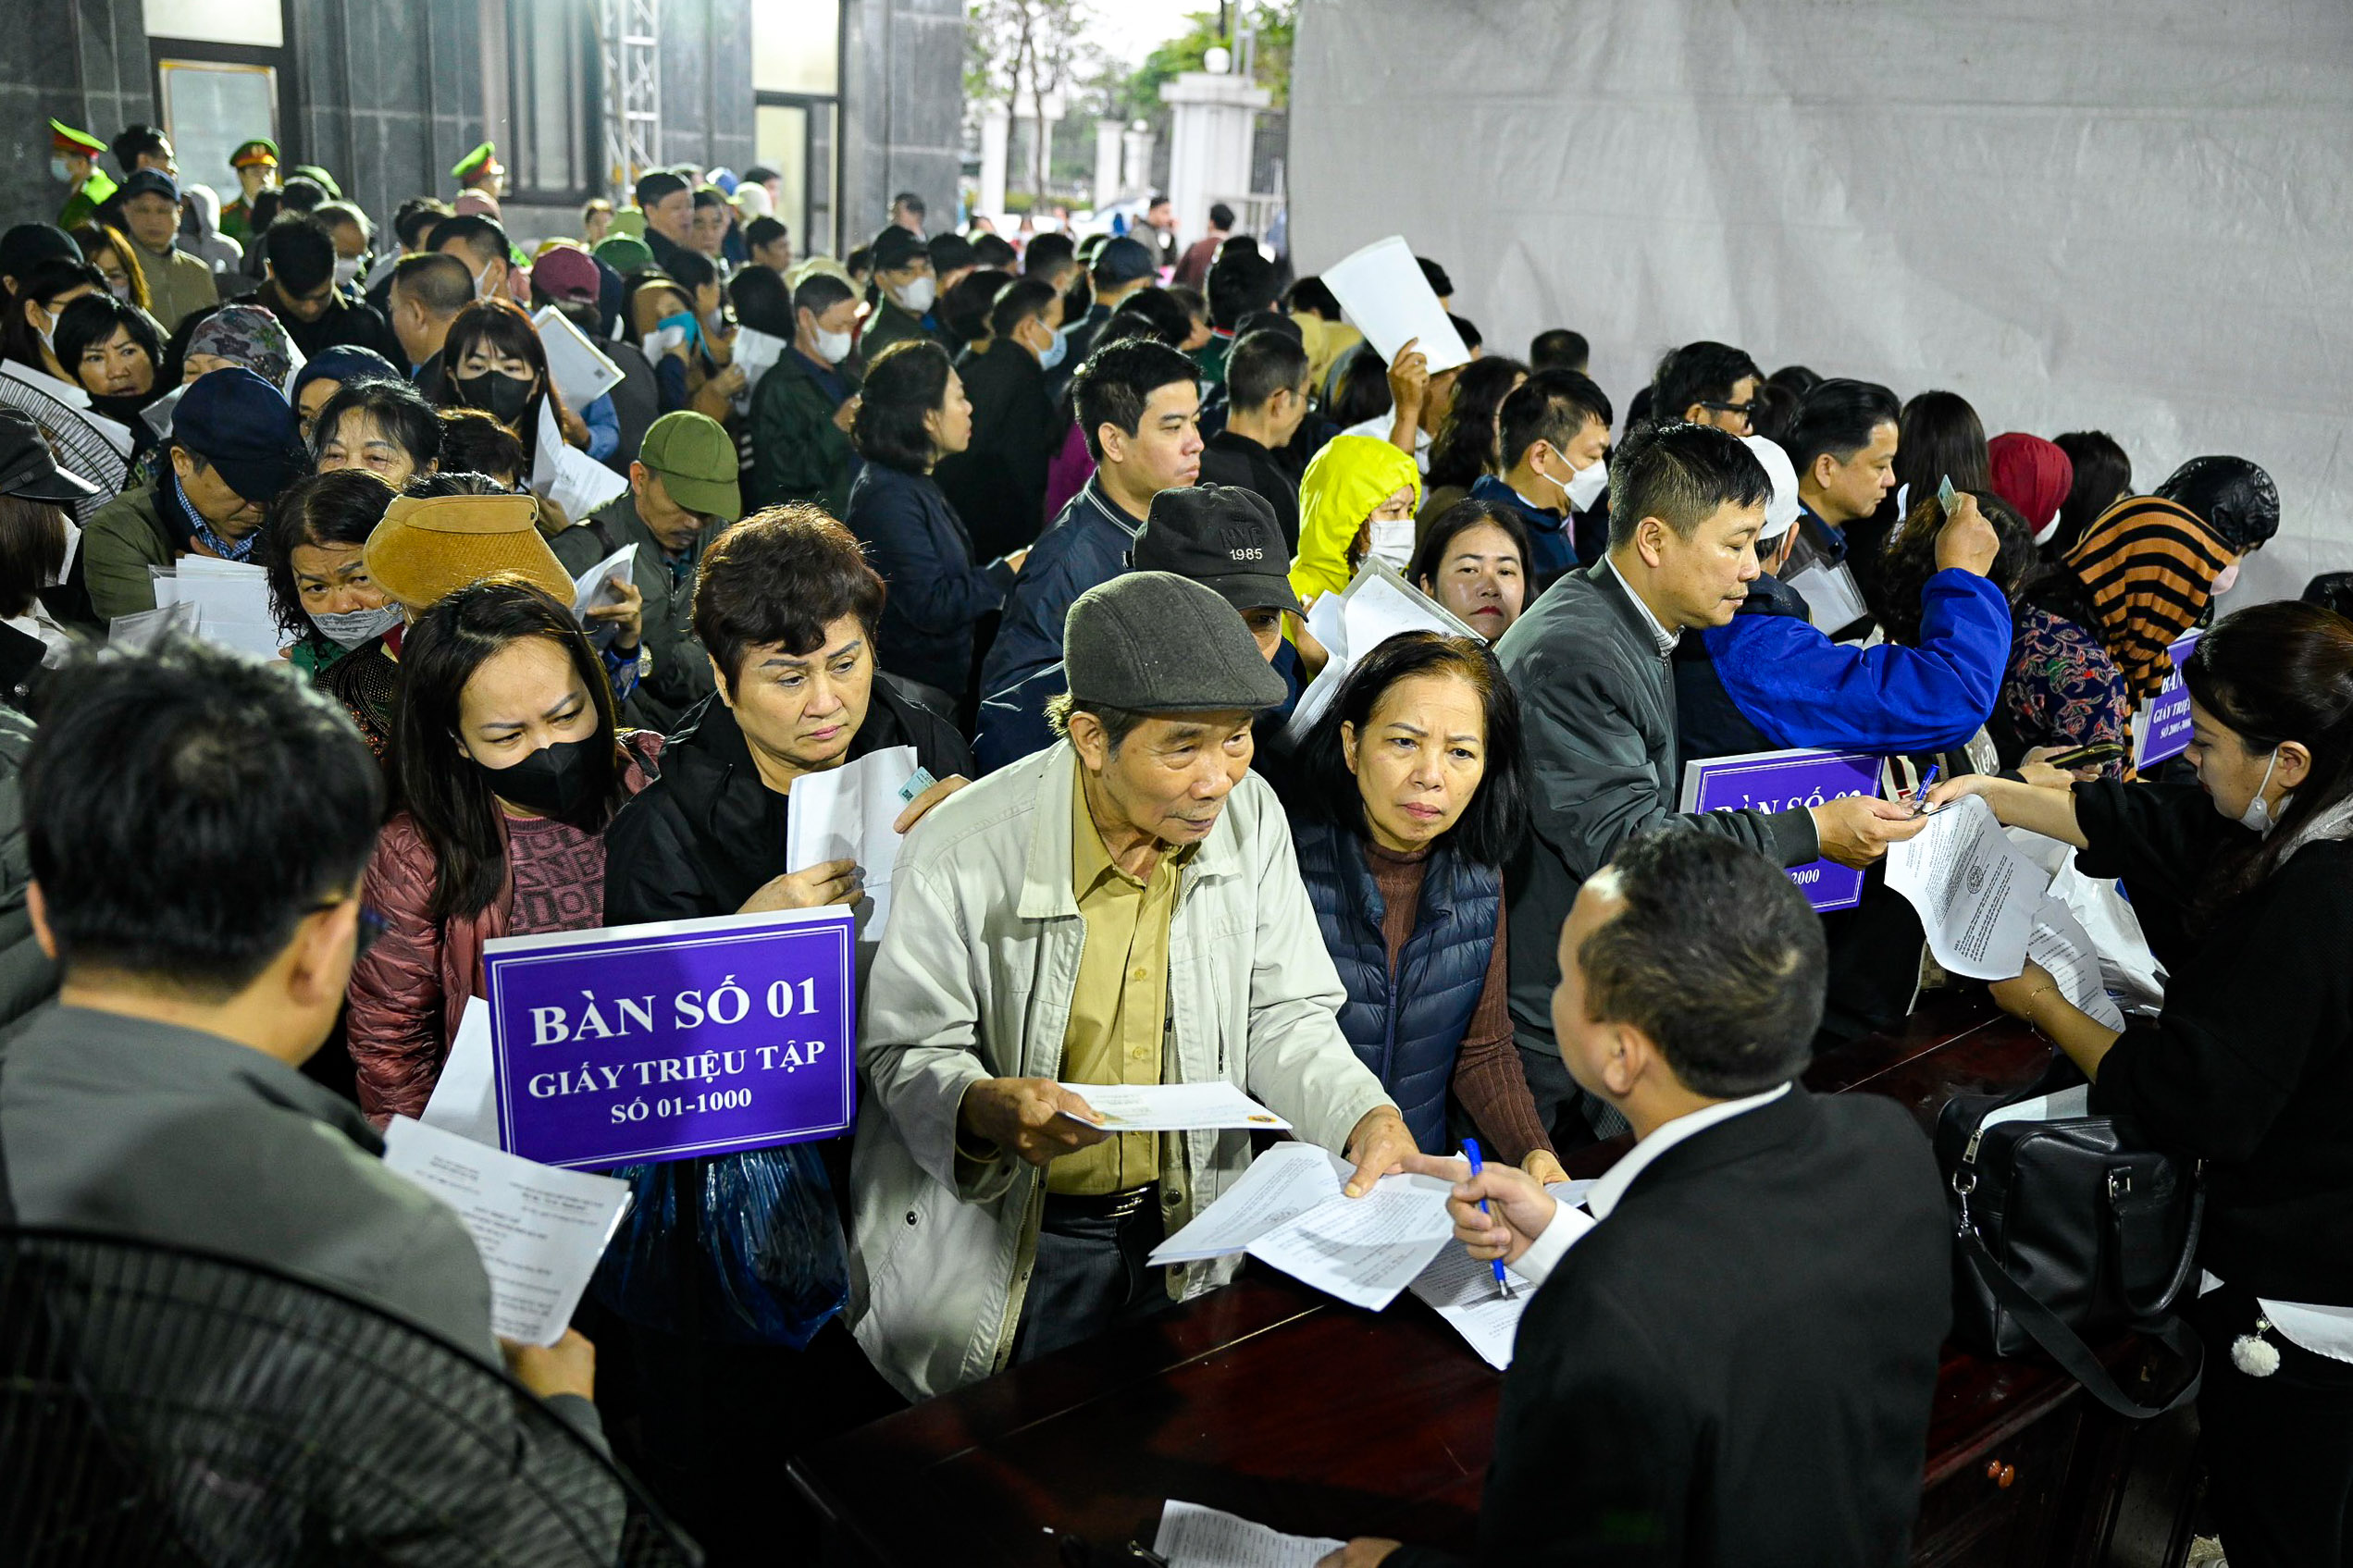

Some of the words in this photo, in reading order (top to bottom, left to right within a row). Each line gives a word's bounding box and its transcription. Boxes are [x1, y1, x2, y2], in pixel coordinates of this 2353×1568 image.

[1230, 549, 1263, 561] 1985
[529, 990, 656, 1047] BÀN
[675, 974, 750, 1031] SỐ
[766, 977, 821, 1019] 01
[528, 1060, 628, 1099] GIẤY
[633, 1049, 748, 1085] TRIỆU
[755, 1040, 826, 1073] TẬP
[611, 1095, 650, 1125] SỐ
[656, 1087, 753, 1118] 01-1000
